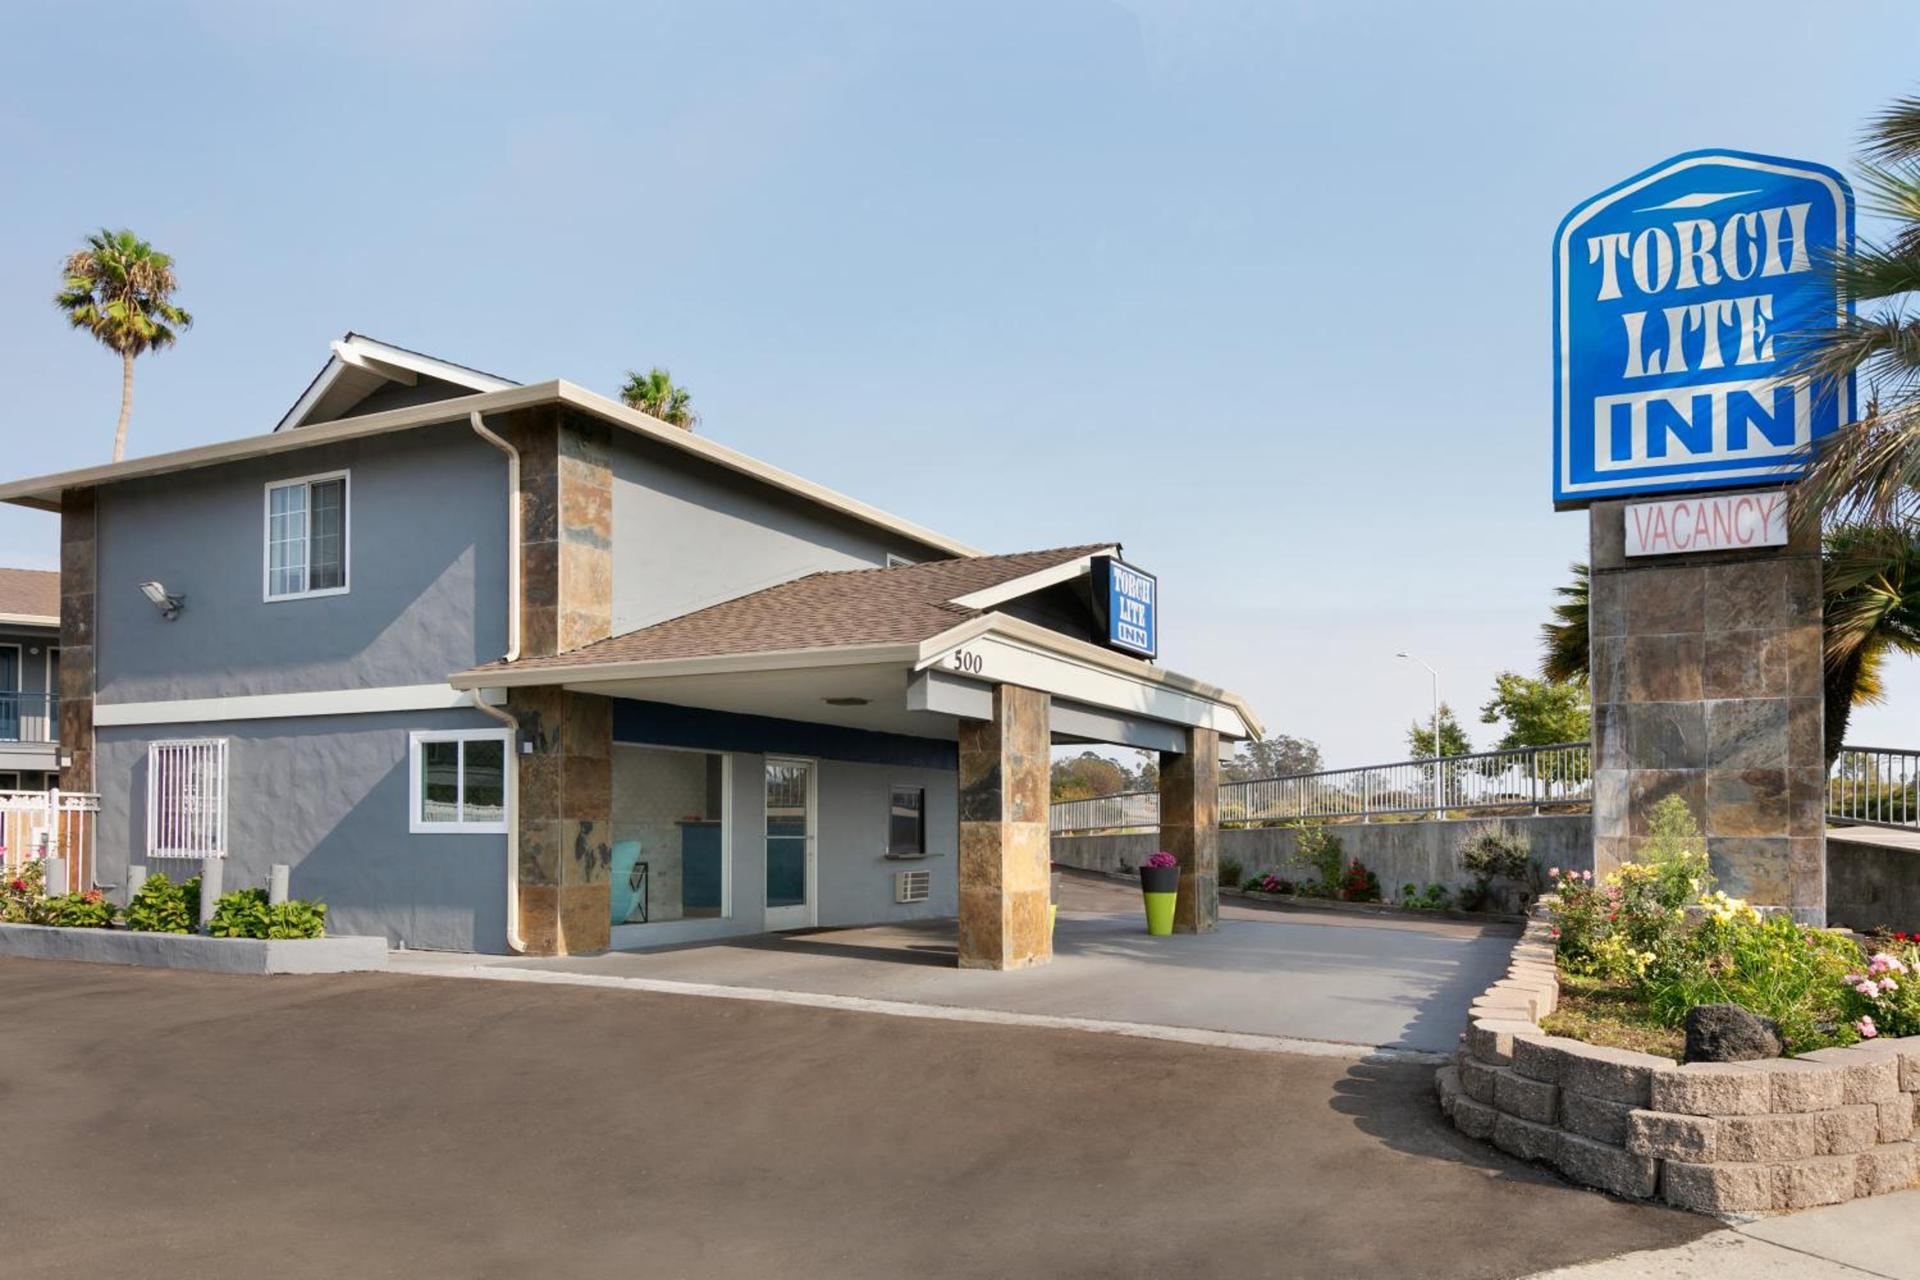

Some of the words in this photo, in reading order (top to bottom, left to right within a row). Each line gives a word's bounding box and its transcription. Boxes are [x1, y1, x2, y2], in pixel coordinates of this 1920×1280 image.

[1587, 202, 1813, 301] TORCH
[1622, 294, 1775, 379] LITE
[1611, 386, 1796, 461] INN
[1633, 496, 1776, 552] VACANCY
[1114, 567, 1150, 605] TORCH
[1120, 596, 1145, 628] LITE
[1120, 625, 1145, 645] INN
[954, 649, 982, 673] 500
